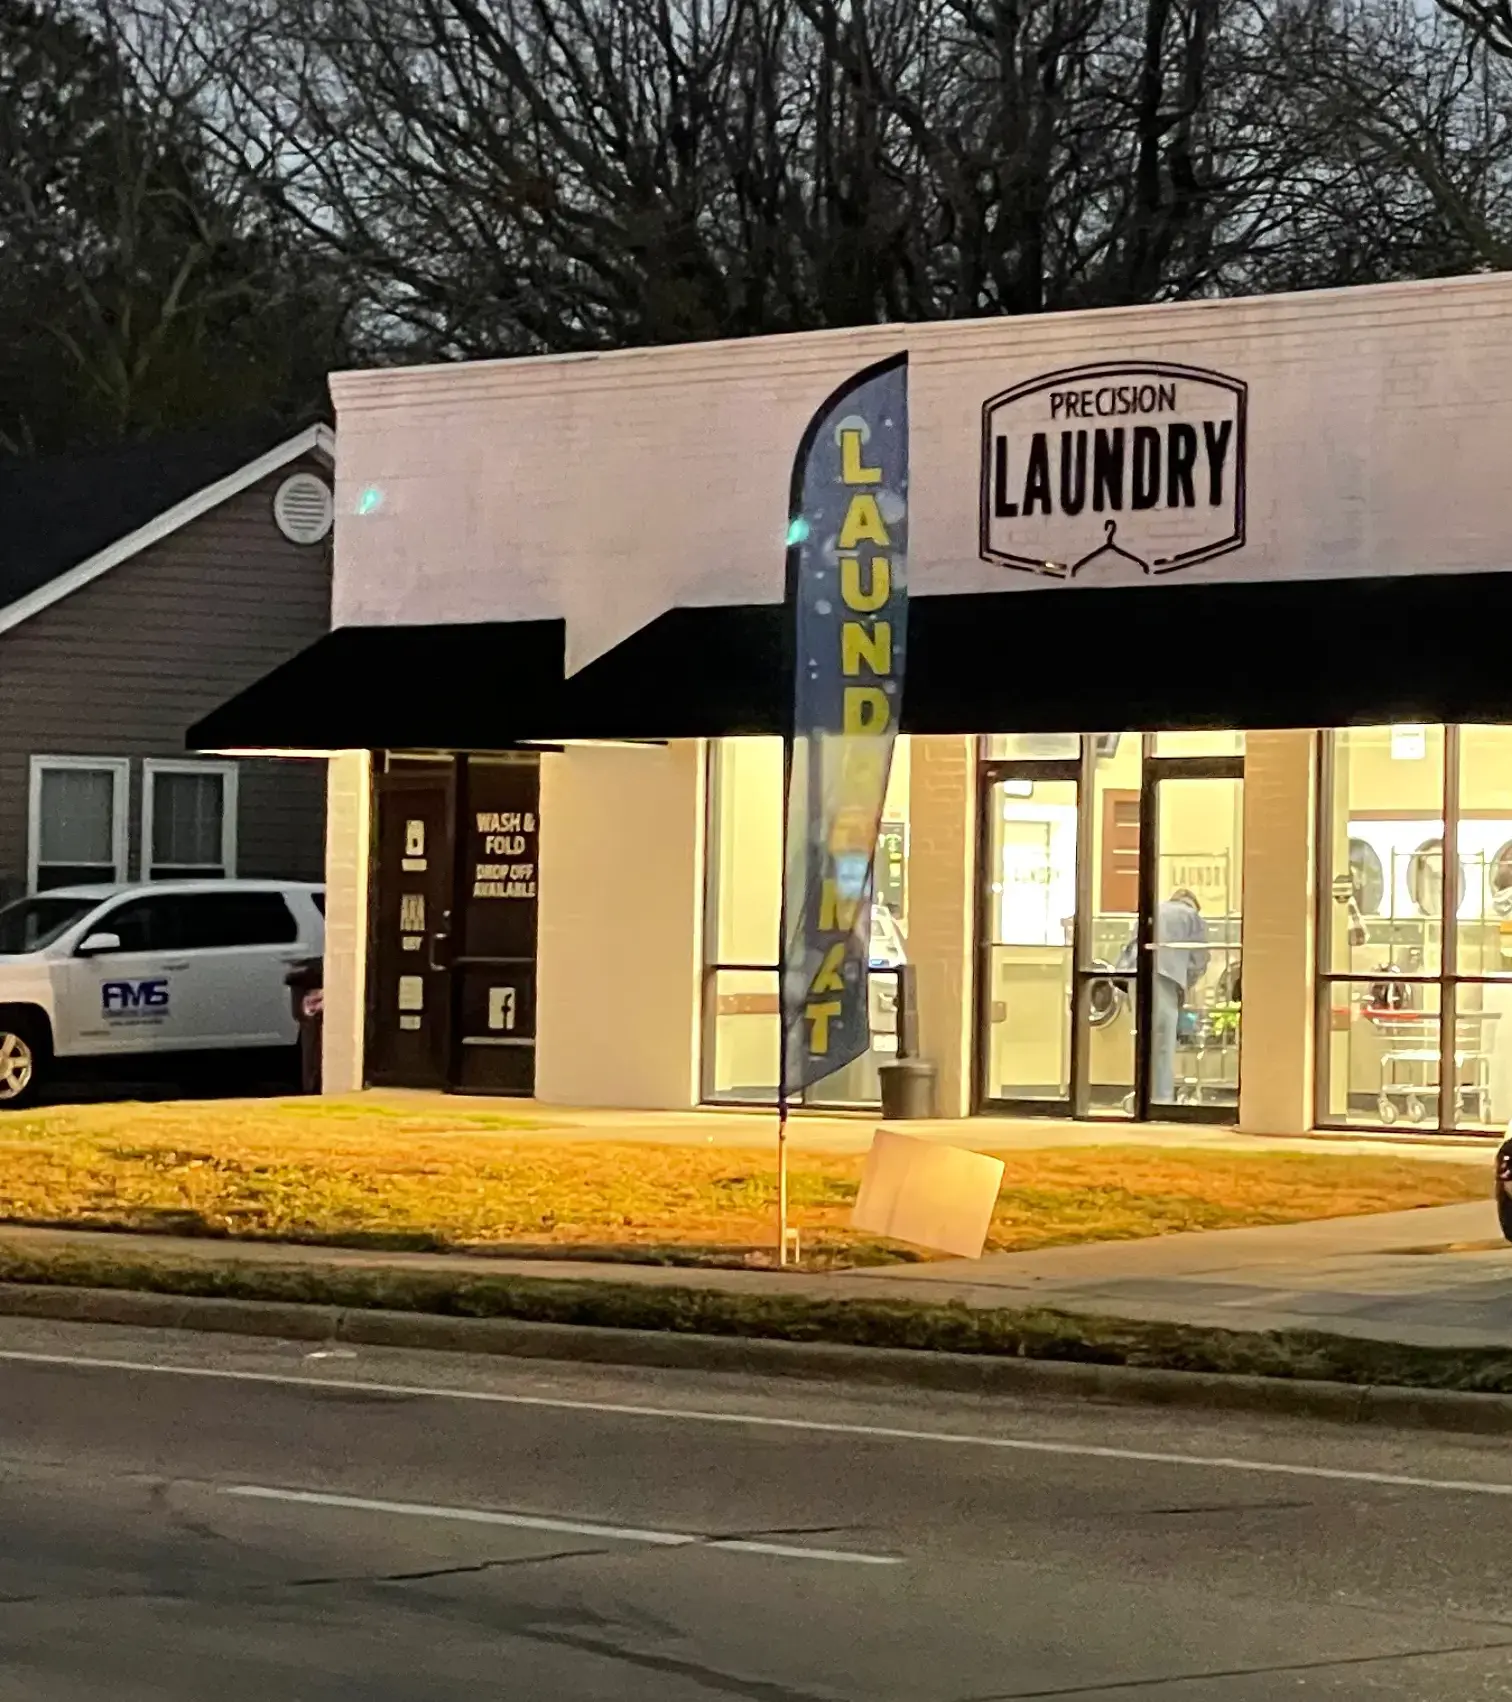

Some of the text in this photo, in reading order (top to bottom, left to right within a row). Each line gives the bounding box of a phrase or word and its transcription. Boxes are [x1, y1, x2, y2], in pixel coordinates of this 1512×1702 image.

[1050, 383, 1176, 420] PRECISION
[995, 420, 1233, 517] LAUNDRY
[804, 430, 891, 1054] LAUNDMAT
[476, 812, 536, 832] WASH &
[485, 835, 525, 855] FOLD
[476, 864, 534, 880] DROP OFF
[473, 882, 536, 898] AVAILABLE
[102, 980, 169, 1008] FMS
